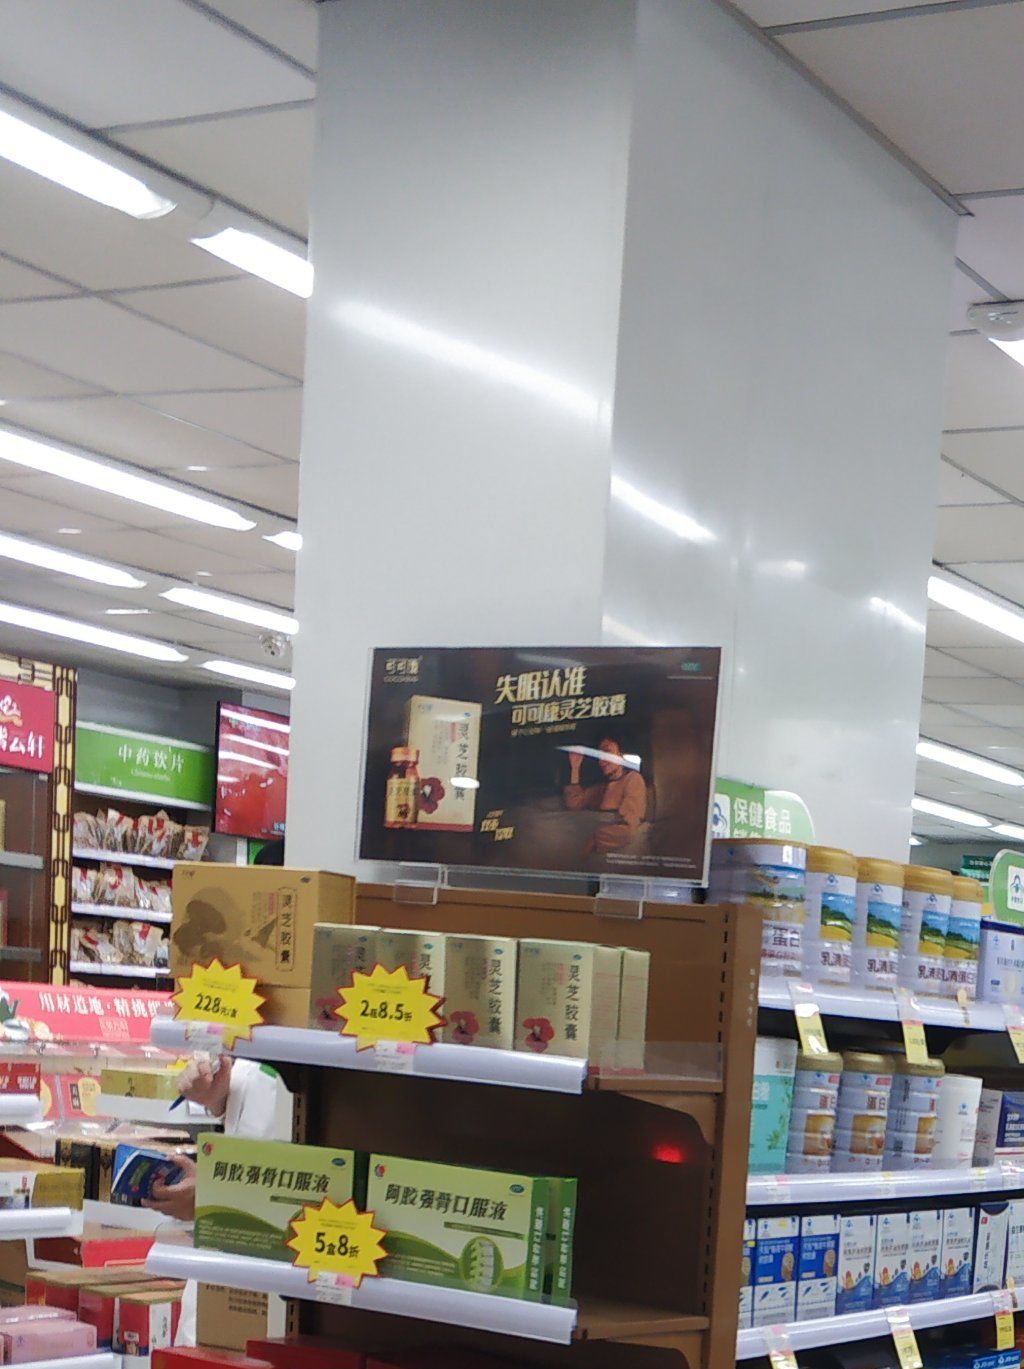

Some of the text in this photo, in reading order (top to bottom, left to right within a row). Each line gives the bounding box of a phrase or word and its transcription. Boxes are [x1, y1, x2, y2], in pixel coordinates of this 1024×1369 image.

[117, 743, 184, 774] 中药饮片
[733, 797, 792, 835] 保健食品
[213, 1160, 330, 1193] 阿胶强骨口服液
[385, 1183, 508, 1221] 阿胶强骨口服液
[314, 1231, 359, 1259] 5盒8折
